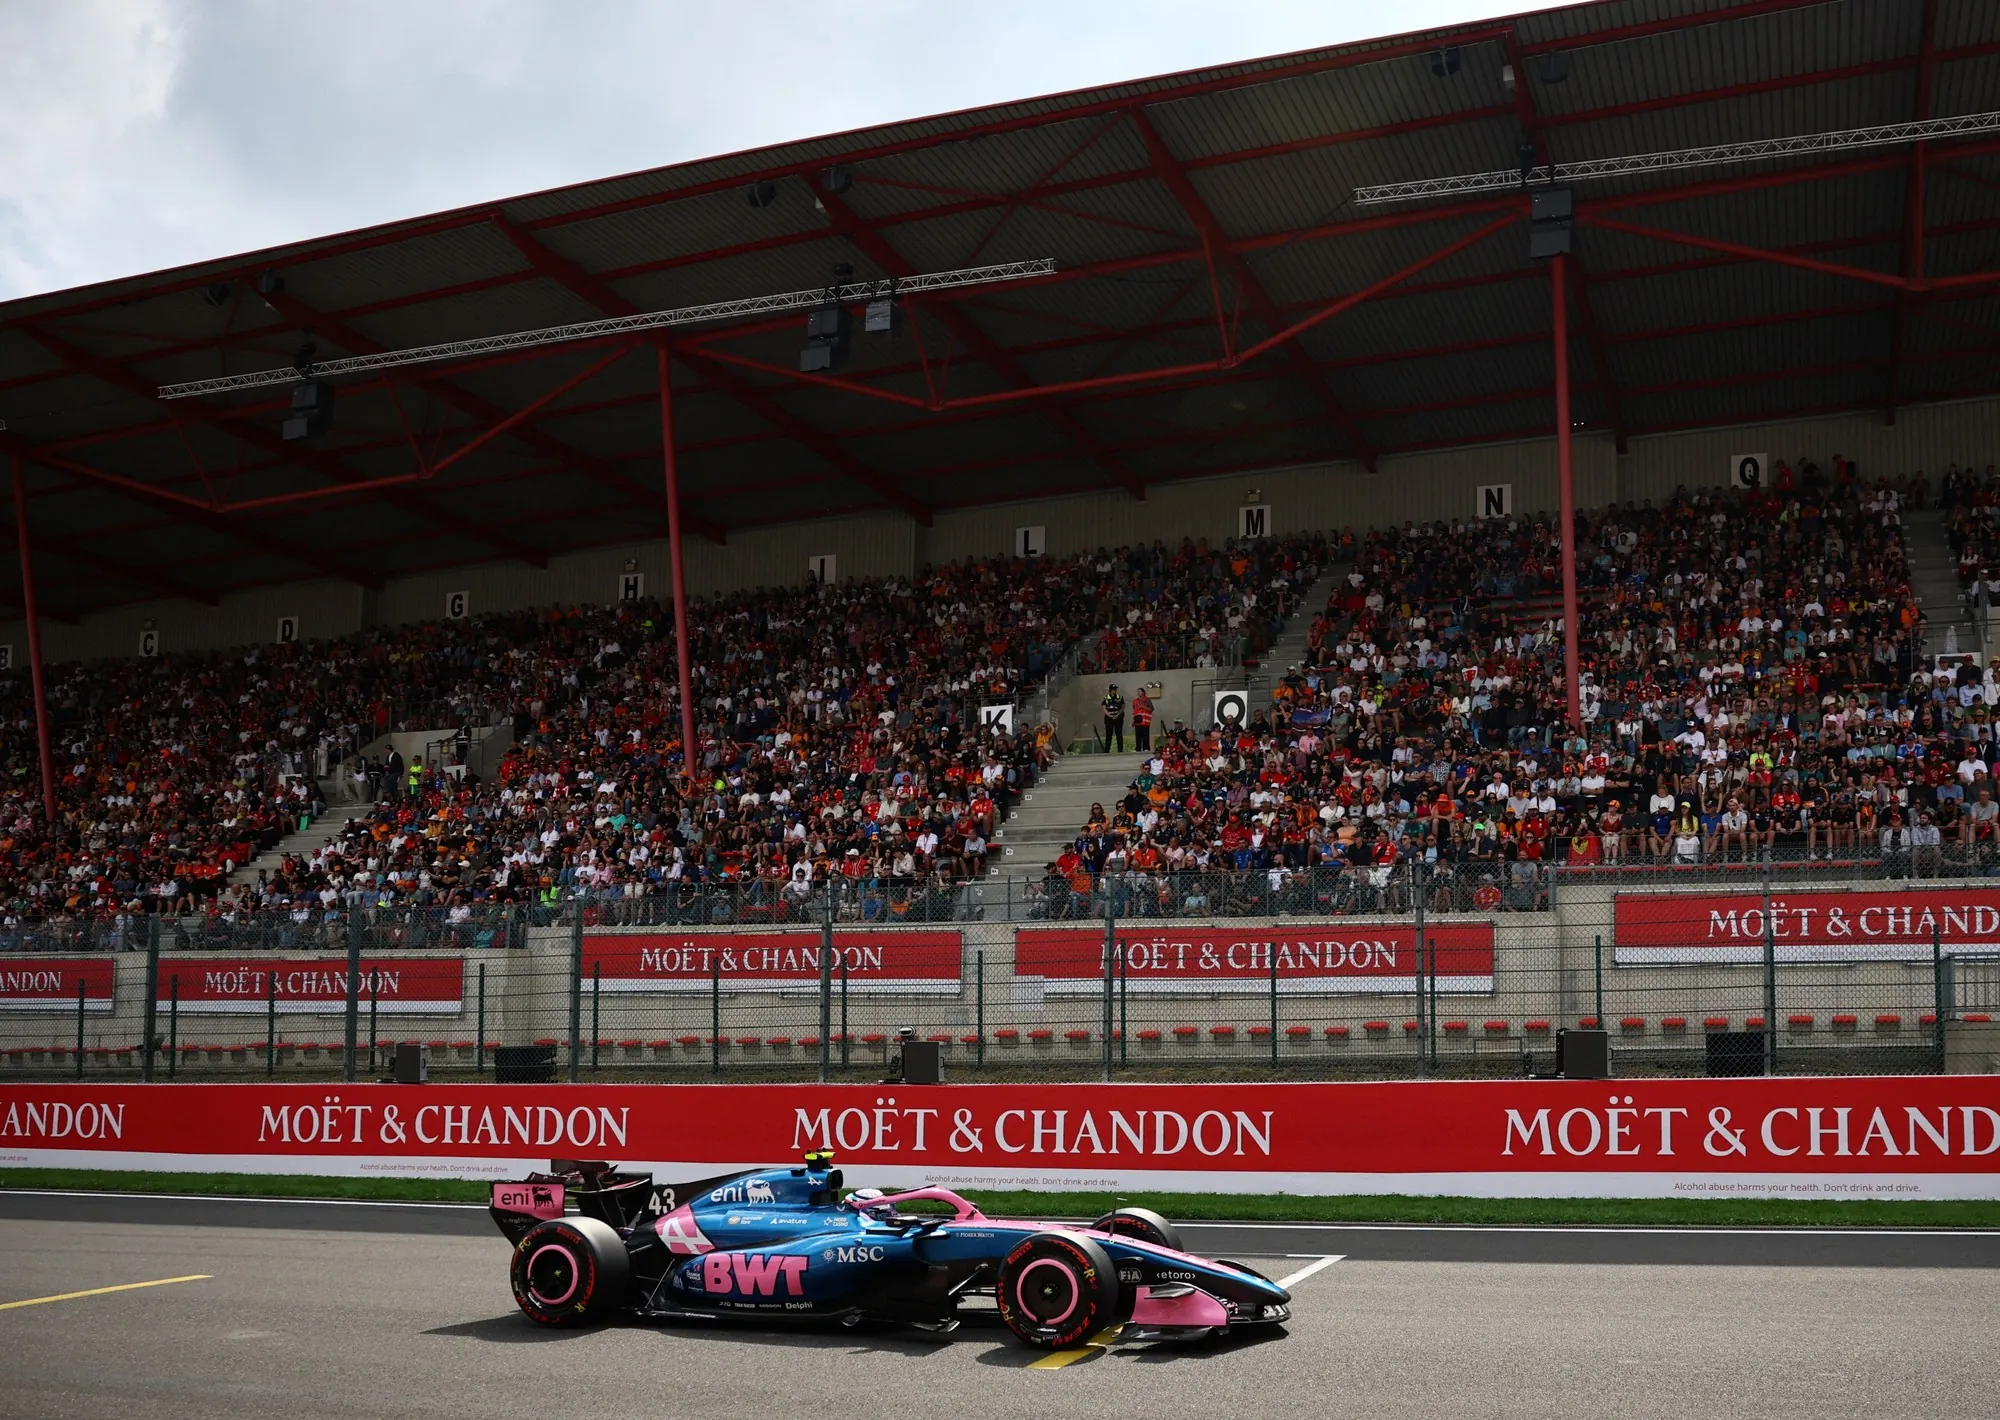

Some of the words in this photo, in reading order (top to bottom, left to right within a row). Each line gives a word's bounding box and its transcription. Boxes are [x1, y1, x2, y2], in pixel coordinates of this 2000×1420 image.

[1740, 458, 1760, 487] Q
[1485, 488, 1503, 514] N
[1246, 508, 1265, 535] M
[1023, 530, 1037, 555] L
[625, 577, 638, 599] H
[451, 594, 463, 617] G
[281, 619, 294, 642] D
[144, 634, 154, 655] C
[985, 708, 1007, 730] K
[1216, 694, 1246, 726] O
[1707, 902, 1817, 938] MOËT
[1826, 907, 1852, 937] &
[640, 942, 715, 972] MOËT
[720, 947, 738, 971] &
[1199, 942, 1221, 969] &
[1226, 940, 1397, 969] CHANDON
[204, 966, 265, 994] MOËT
[257, 1096, 372, 1143] MOËT
[379, 1104, 407, 1144] &
[414, 1105, 630, 1147] CHANDON
[790, 1097, 938, 1152] MOËT
[949, 1108, 983, 1153] &
[994, 1109, 1274, 1157] CHANDON
[1501, 1095, 1689, 1157] MOËT
[1703, 1106, 1747, 1157] &
[1760, 1106, 2000, 1157] CHAND
[710, 1181, 743, 1202] eni
[924, 1174, 950, 1183] Alcohol
[951, 1175, 973, 1183] abuse
[974, 1175, 996, 1184] harms
[997, 1177, 1014, 1186] your
[1062, 1177, 1082, 1186] drink
[1083, 1178, 1098, 1187] and
[1673, 1182, 1706, 1192] Alcohol
[1708, 1182, 1735, 1192] abuse
[1737, 1182, 1766, 1192] harms
[1767, 1184, 1788, 1194] your
[1790, 1183, 1822, 1192] health.
[1823, 1183, 1848, 1193] Don't
[1849, 1183, 1874, 1193] drink
[1875, 1183, 1893, 1193] and
[1895, 1184, 1922, 1193] drive.
[501, 1188, 529, 1206] eni
[648, 1187, 676, 1215] 43
[778, 1217, 808, 1225] avature
[836, 1246, 885, 1263] MSC
[703, 1252, 809, 1297] BWT
[785, 1301, 813, 1310] Delphi
